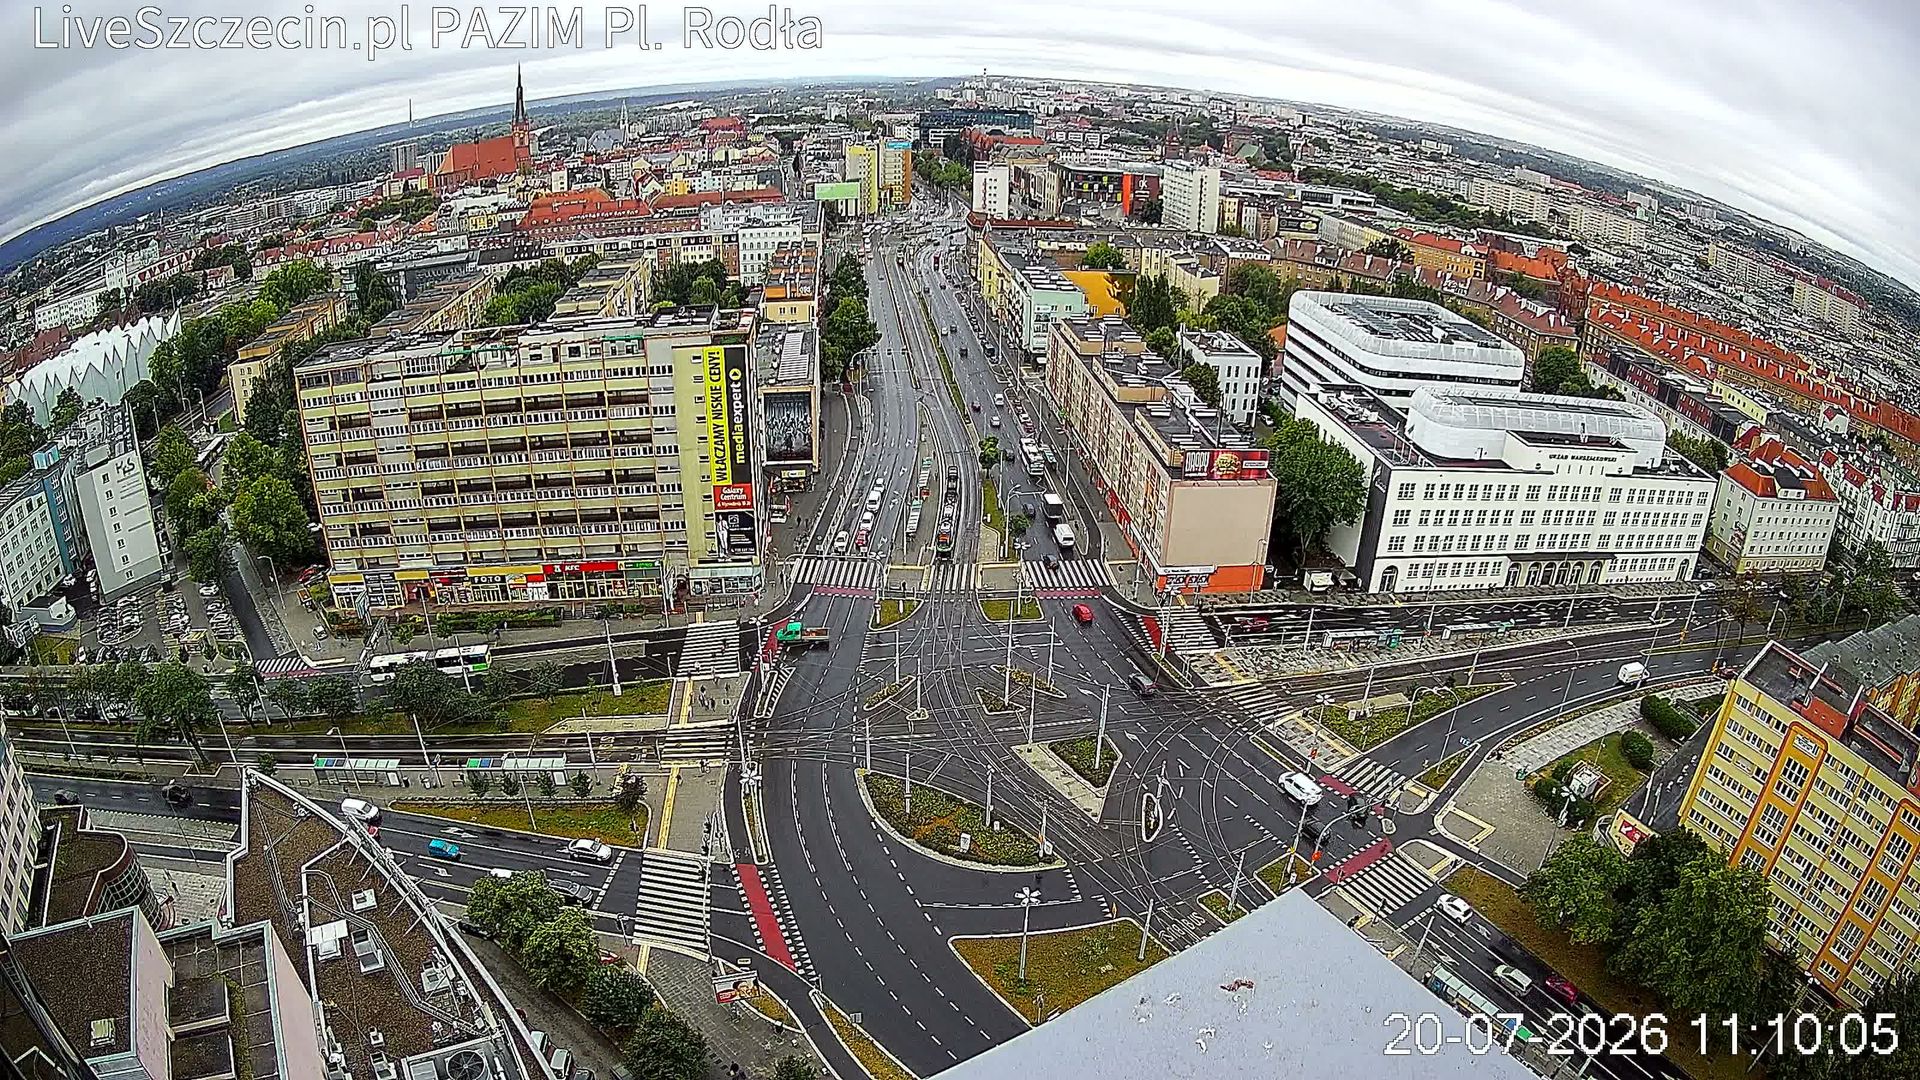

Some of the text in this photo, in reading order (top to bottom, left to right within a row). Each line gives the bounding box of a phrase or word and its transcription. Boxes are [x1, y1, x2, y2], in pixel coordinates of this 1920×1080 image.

[708, 351, 721, 382] CENY!
[710, 385, 724, 420] NISKIE
[730, 382, 745, 464] mediaexpert
[1181, 912, 1206, 930] BUS
